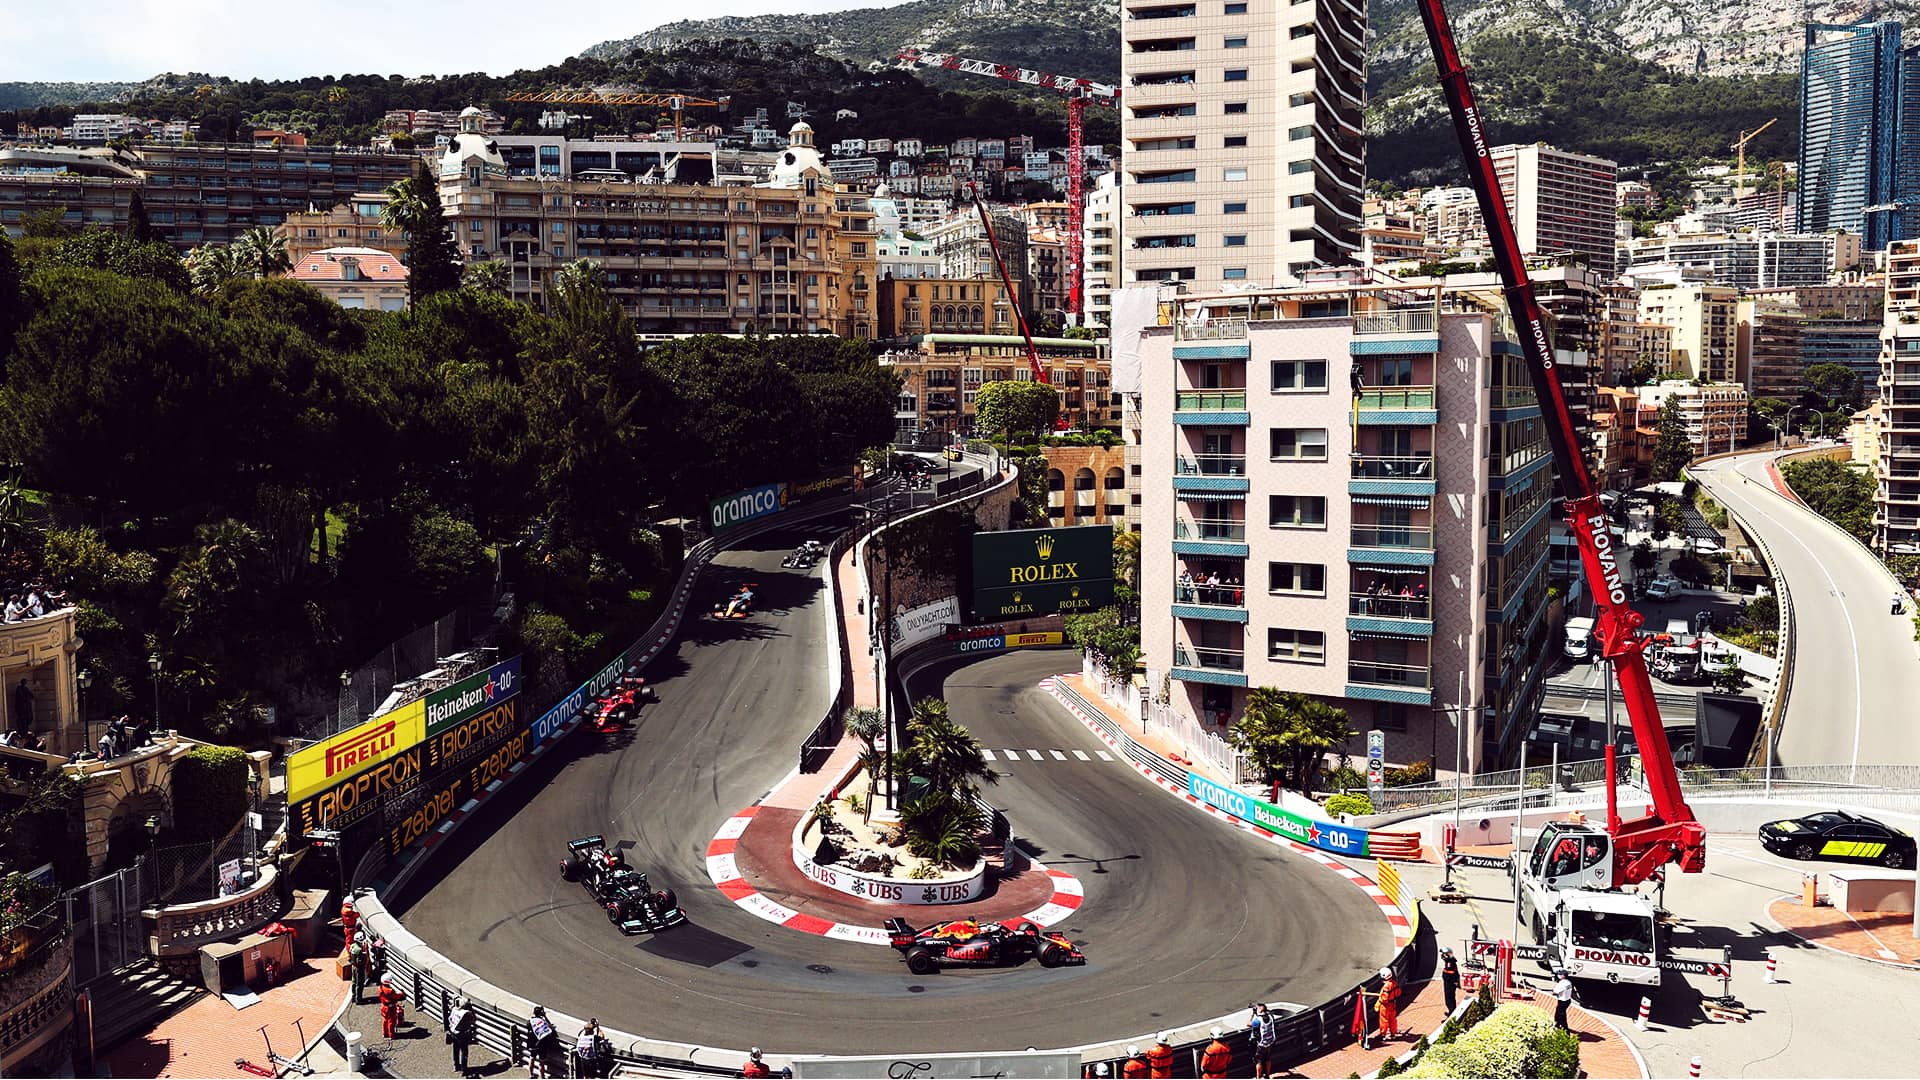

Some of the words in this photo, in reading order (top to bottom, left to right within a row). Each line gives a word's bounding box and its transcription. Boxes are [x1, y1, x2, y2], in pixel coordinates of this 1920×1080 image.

[1465, 107, 1487, 157] PIOVANO
[1531, 320, 1552, 369] PIOVANO
[713, 489, 774, 527] aramco
[1009, 563, 1079, 583] ROLEX
[1588, 515, 1625, 605] PIOVANO
[1001, 604, 1034, 614] ROLEX
[1060, 599, 1090, 609] ROLEX
[960, 637, 1001, 651] aramco
[1018, 634, 1048, 644] PIRELLI
[589, 658, 624, 697] aramco
[427, 687, 482, 726] Heineken
[539, 693, 581, 738] aramco
[442, 700, 515, 759] BIOPTRON
[325, 720, 396, 778] PIRELLI
[318, 746, 420, 824] BIOPTRON
[1193, 778, 1246, 817] aramco
[1254, 804, 1304, 837] Heineken
[812, 865, 837, 886] UBS
[868, 883, 903, 900] UBS
[940, 883, 969, 901] UBS
[1575, 948, 1651, 966] PIOVANO
[1655, 961, 1704, 972] PIOVANO
